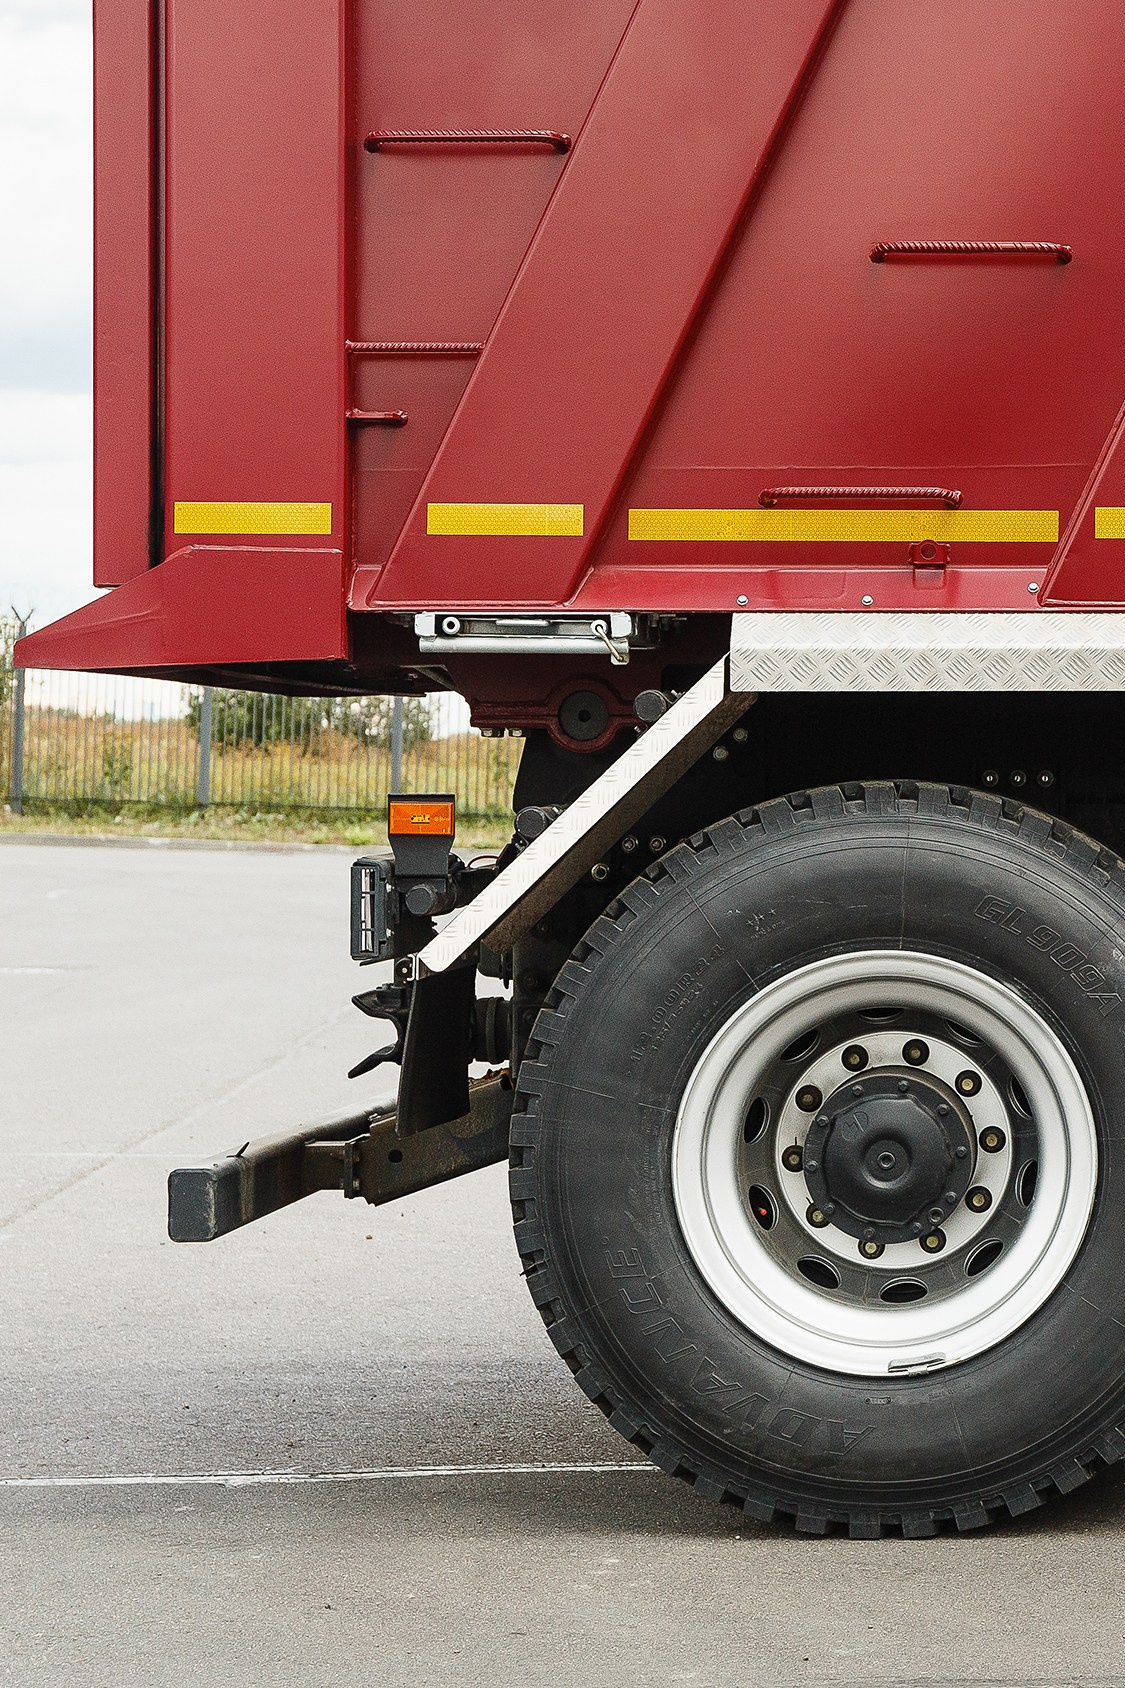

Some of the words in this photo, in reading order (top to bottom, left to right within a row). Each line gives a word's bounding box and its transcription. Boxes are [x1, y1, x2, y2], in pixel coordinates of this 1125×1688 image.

[974, 894, 1027, 936] GL
[1026, 925, 1122, 1017] 909A
[604, 1247, 876, 1456] ADVANCE
